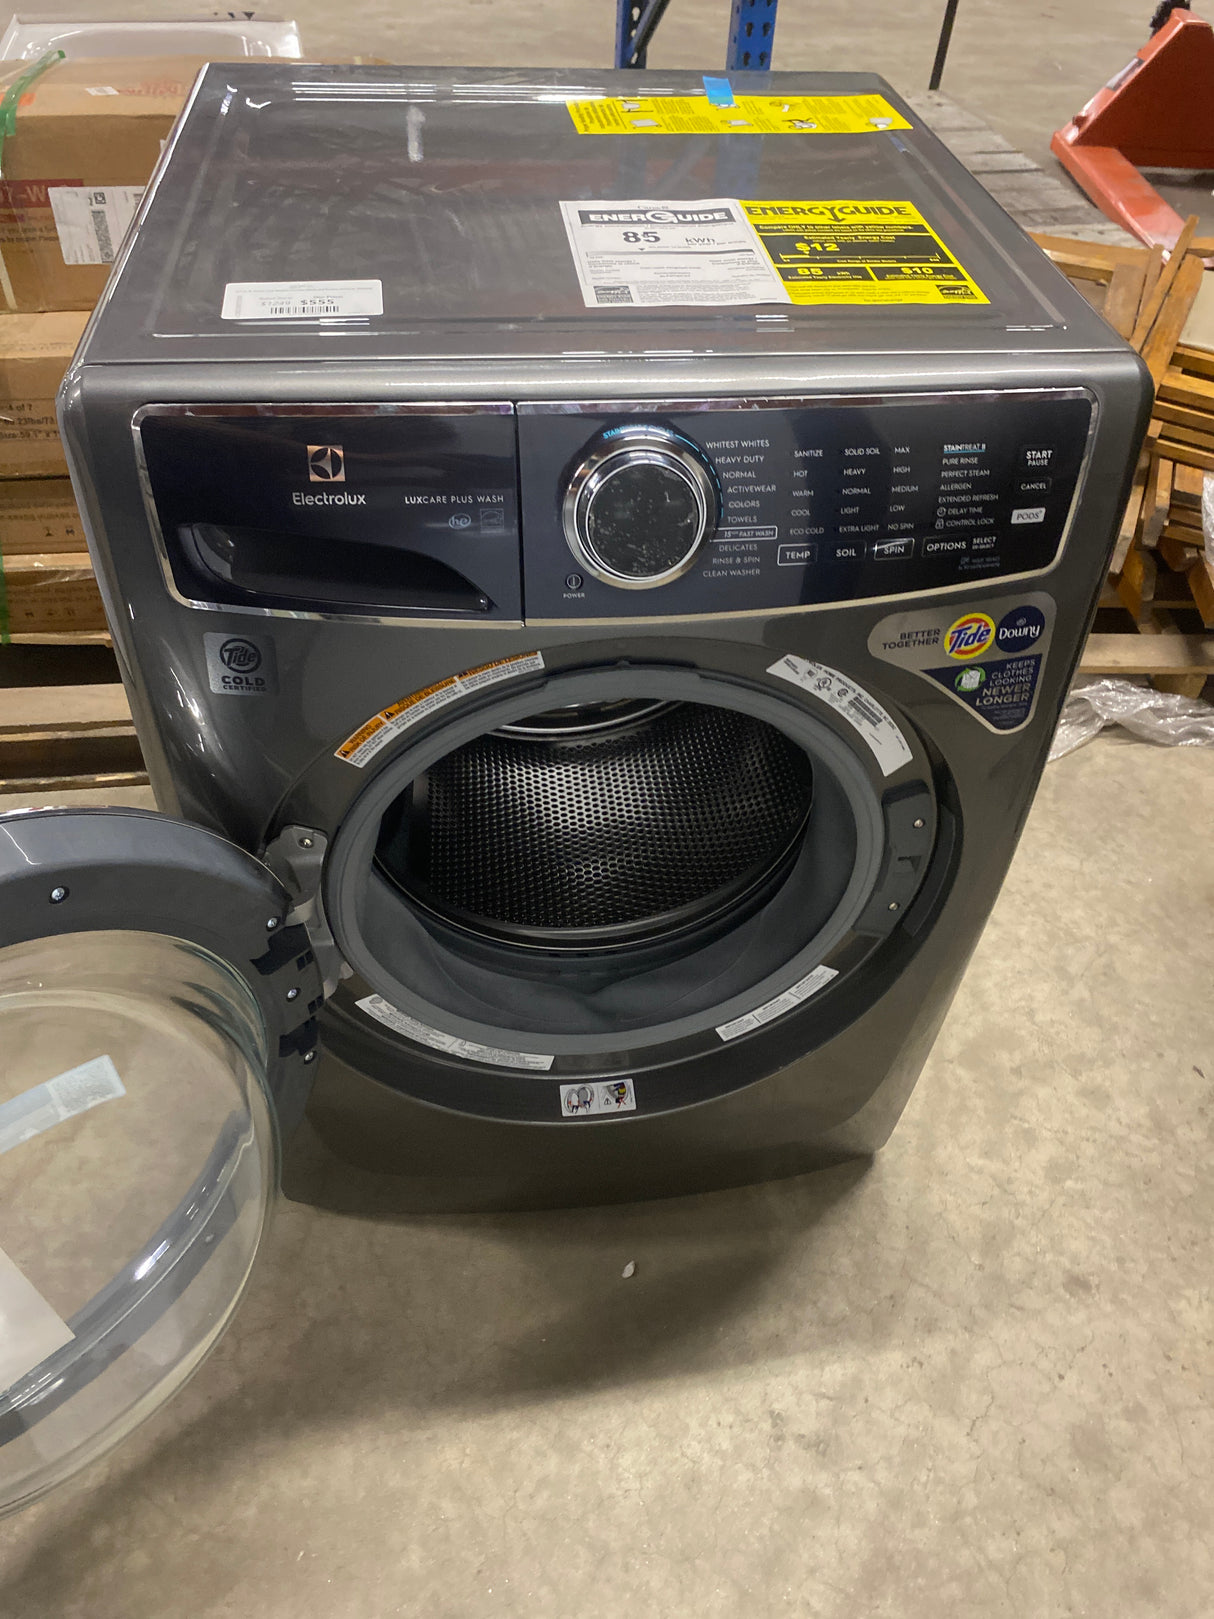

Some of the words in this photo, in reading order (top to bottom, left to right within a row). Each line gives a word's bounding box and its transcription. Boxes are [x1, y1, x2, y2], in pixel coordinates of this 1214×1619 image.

[588, 209, 729, 224] ENERGUIDE
[745, 205, 912, 219] ENERGYGUIDE
[622, 231, 661, 244] 85
[795, 242, 840, 251] $12
[901, 267, 933, 275] $10
[706, 440, 739, 449] WHITEST
[740, 439, 770, 448] WHITES
[943, 443, 981, 452] STAINTREAT
[794, 449, 823, 458] SANITIZE
[865, 447, 881, 455] SOIL
[894, 446, 910, 454] MAX
[1026, 450, 1053, 459] START
[715, 456, 741, 464] HEAVY
[743, 455, 765, 463] DUTY
[1027, 459, 1049, 467] PAUSE
[793, 470, 808, 478] HOT
[843, 468, 866, 476] HEAVY
[893, 465, 911, 474] HIGH
[941, 470, 968, 478] PERFECT
[968, 469, 990, 477] STEAM
[722, 471, 756, 479] NORMAL
[727, 485, 777, 493] ACTIVEWEAR
[891, 485, 919, 493] MEDIUM
[1020, 482, 1047, 490] CANCEL
[292, 492, 367, 505] Electrolux
[404, 495, 447, 504] LUXCARE
[450, 495, 473, 504] PLUS
[477, 495, 504, 503] WASH
[972, 494, 999, 502] REFRESH
[840, 506, 860, 514] LIGHT
[889, 504, 906, 512] LOW
[977, 518, 995, 526] LOCK
[860, 524, 880, 532] LIGHT
[973, 536, 997, 545] SELECT
[719, 544, 758, 552] DELICATES
[884, 546, 905, 555] SPIN
[926, 541, 967, 551] OPTIONS
[785, 551, 811, 559] TEMP
[836, 549, 857, 558] SOIL
[729, 569, 760, 577] WASHER
[900, 628, 941, 640] BETTER
[998, 625, 1041, 640] Downy
[948, 622, 992, 654] Tide
[882, 637, 940, 650] TOGETHER
[224, 646, 257, 667] Tide
[1006, 659, 1035, 669] KEEPS
[991, 668, 1034, 679] CLOTHES
[221, 675, 266, 687] COLD
[989, 676, 1032, 687] LOOKING
[982, 683, 1031, 696] NEWER
[975, 693, 1030, 706] LONGER
